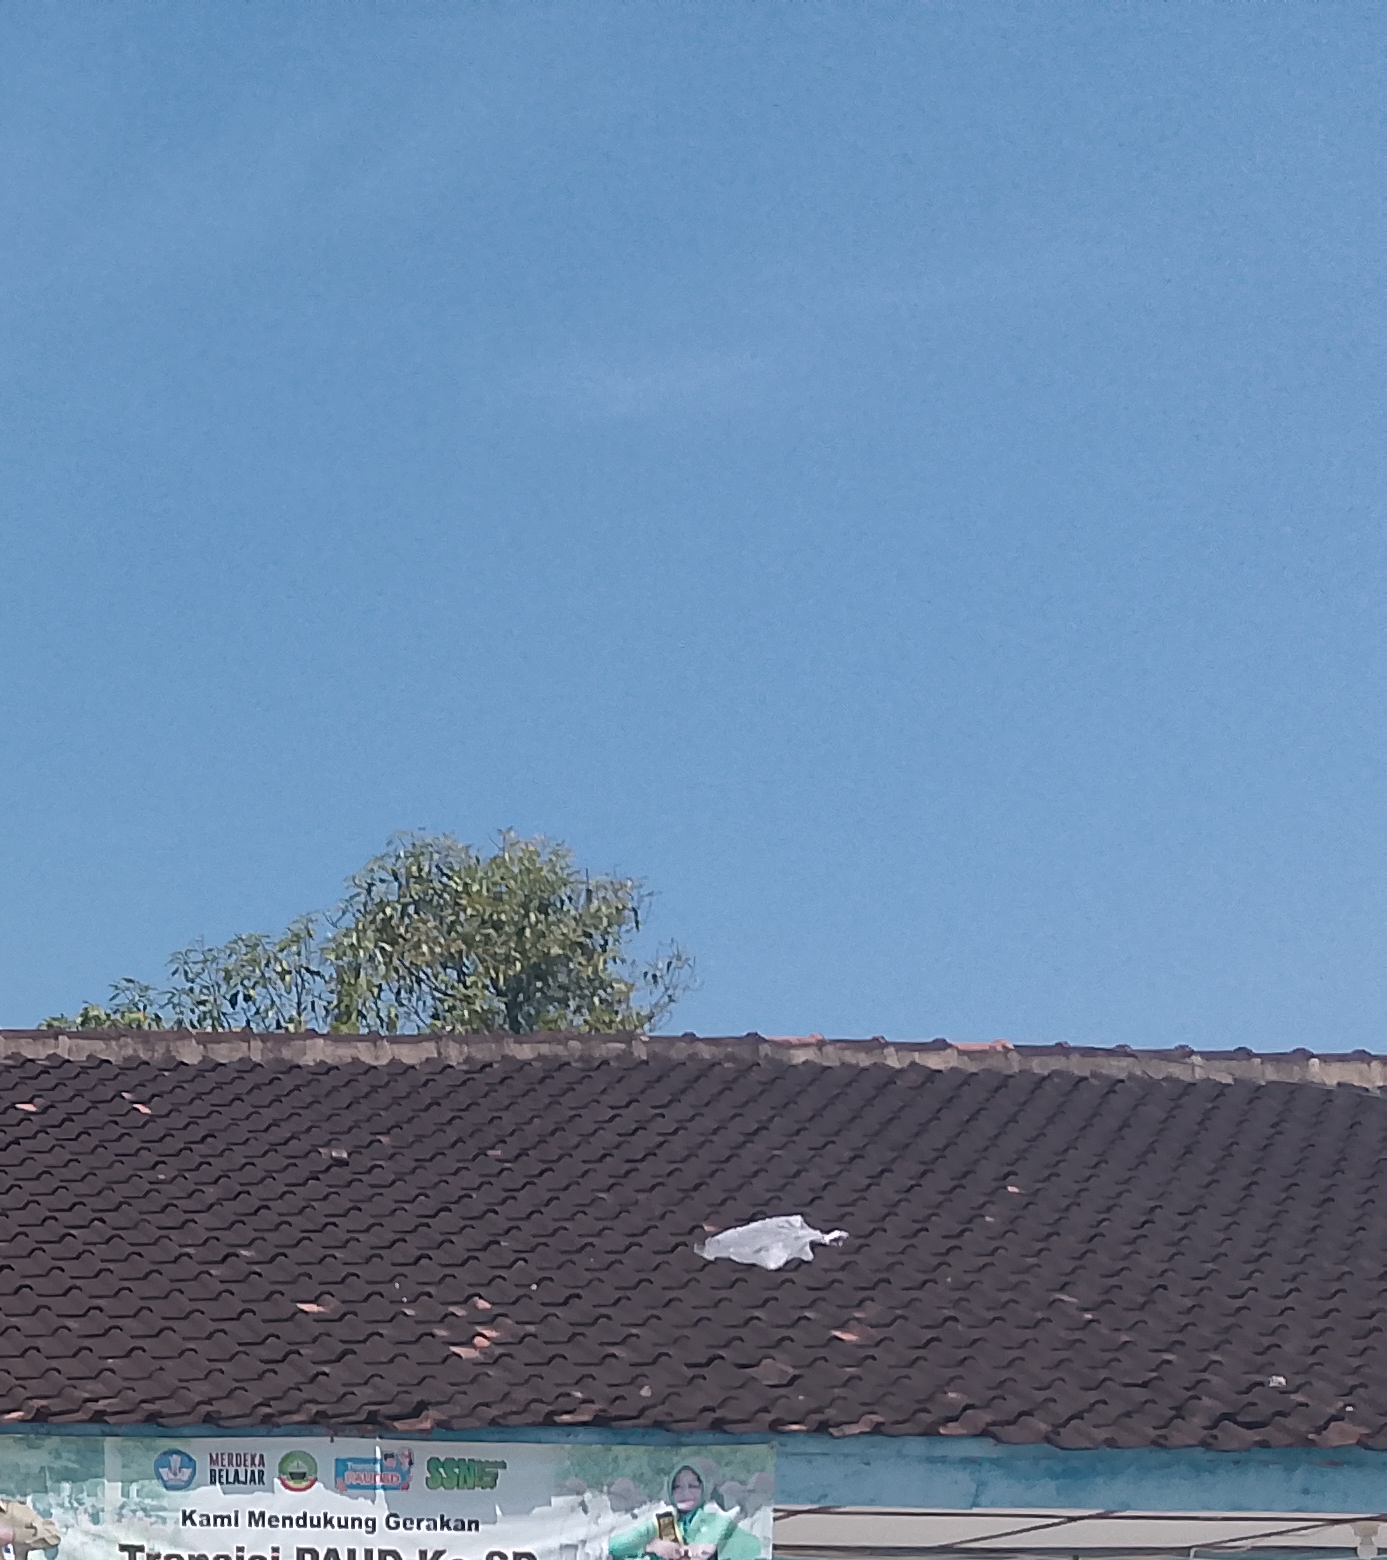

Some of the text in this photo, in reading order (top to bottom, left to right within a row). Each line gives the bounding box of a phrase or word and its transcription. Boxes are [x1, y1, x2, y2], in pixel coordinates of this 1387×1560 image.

[209, 1453, 266, 1469] MERDEKA
[209, 1469, 266, 1486] BELAJAR
[181, 1509, 480, 1535] Kami Mendukung Gerakan
